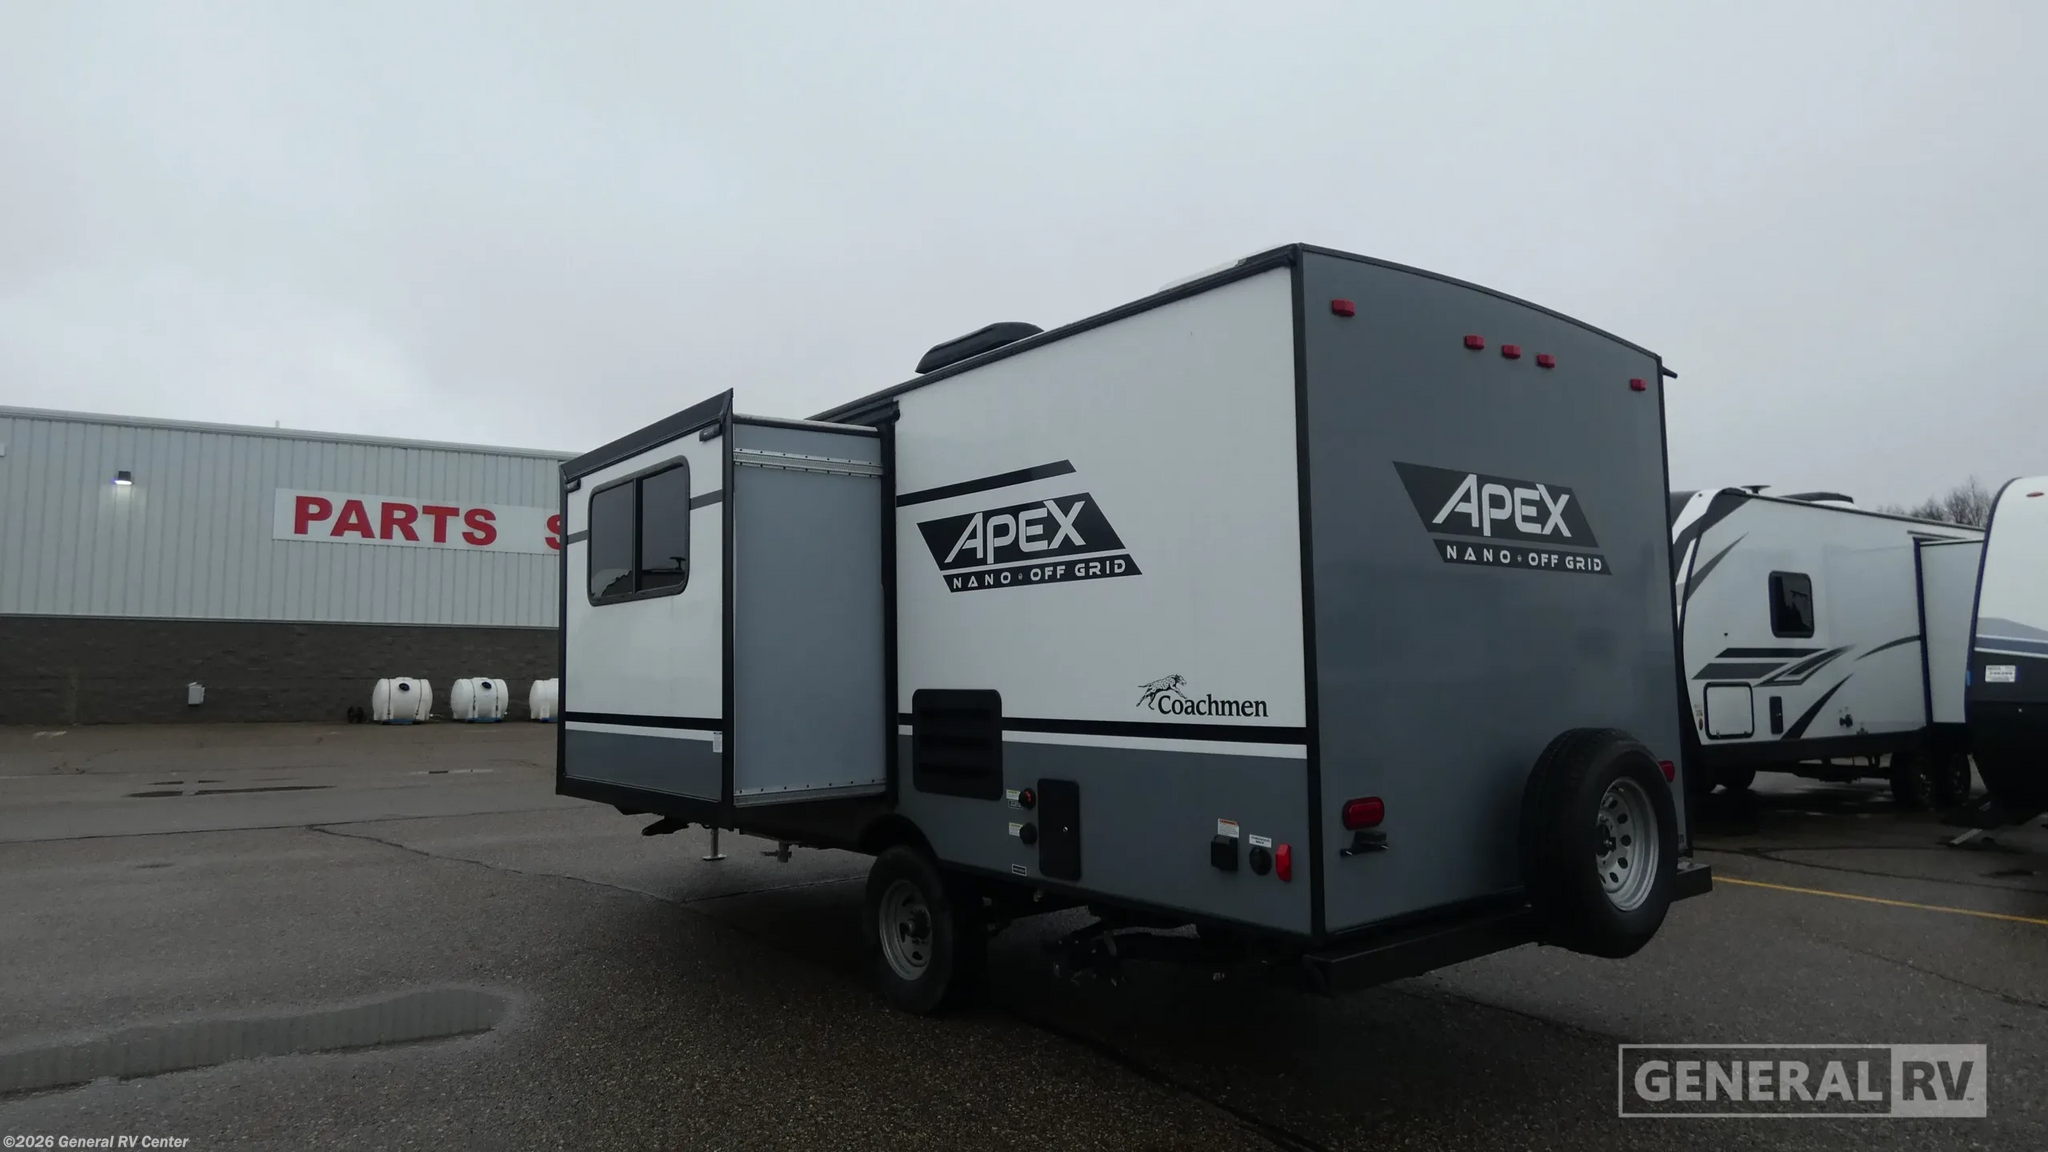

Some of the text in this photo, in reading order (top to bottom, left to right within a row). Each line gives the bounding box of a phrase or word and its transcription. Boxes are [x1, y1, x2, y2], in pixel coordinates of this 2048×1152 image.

[294, 496, 496, 546] PARTS
[1432, 473, 1572, 537] APEX
[944, 499, 1087, 564] APEX
[953, 559, 1127, 589] NANO OFF GRID
[1446, 544, 1602, 572] NANO OFF GRID
[1158, 693, 1269, 718] Coachmen
